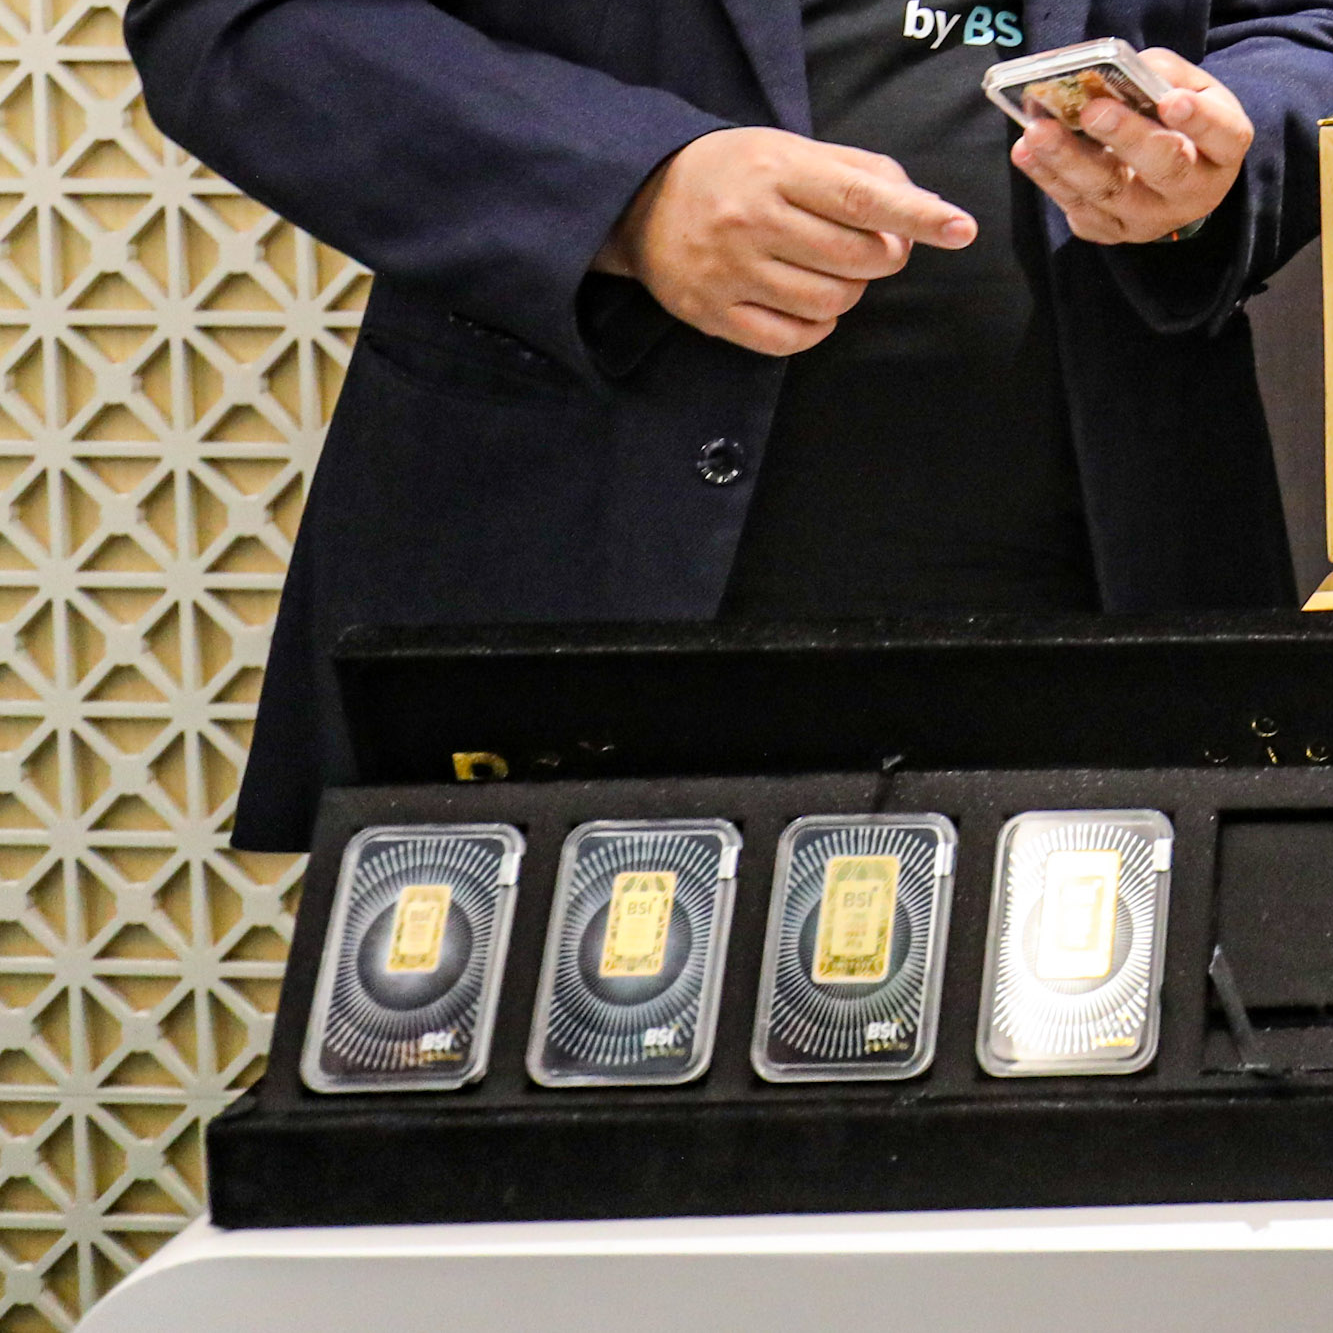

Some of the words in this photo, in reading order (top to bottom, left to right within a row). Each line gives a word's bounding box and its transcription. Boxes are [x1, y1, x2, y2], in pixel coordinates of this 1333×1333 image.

[903, 0, 961, 49] by
[963, 6, 1023, 47] BS
[627, 901, 654, 915] BSI
[843, 892, 874, 908] BSI
[644, 1027, 677, 1047] BSI
[867, 1021, 899, 1039] BSI
